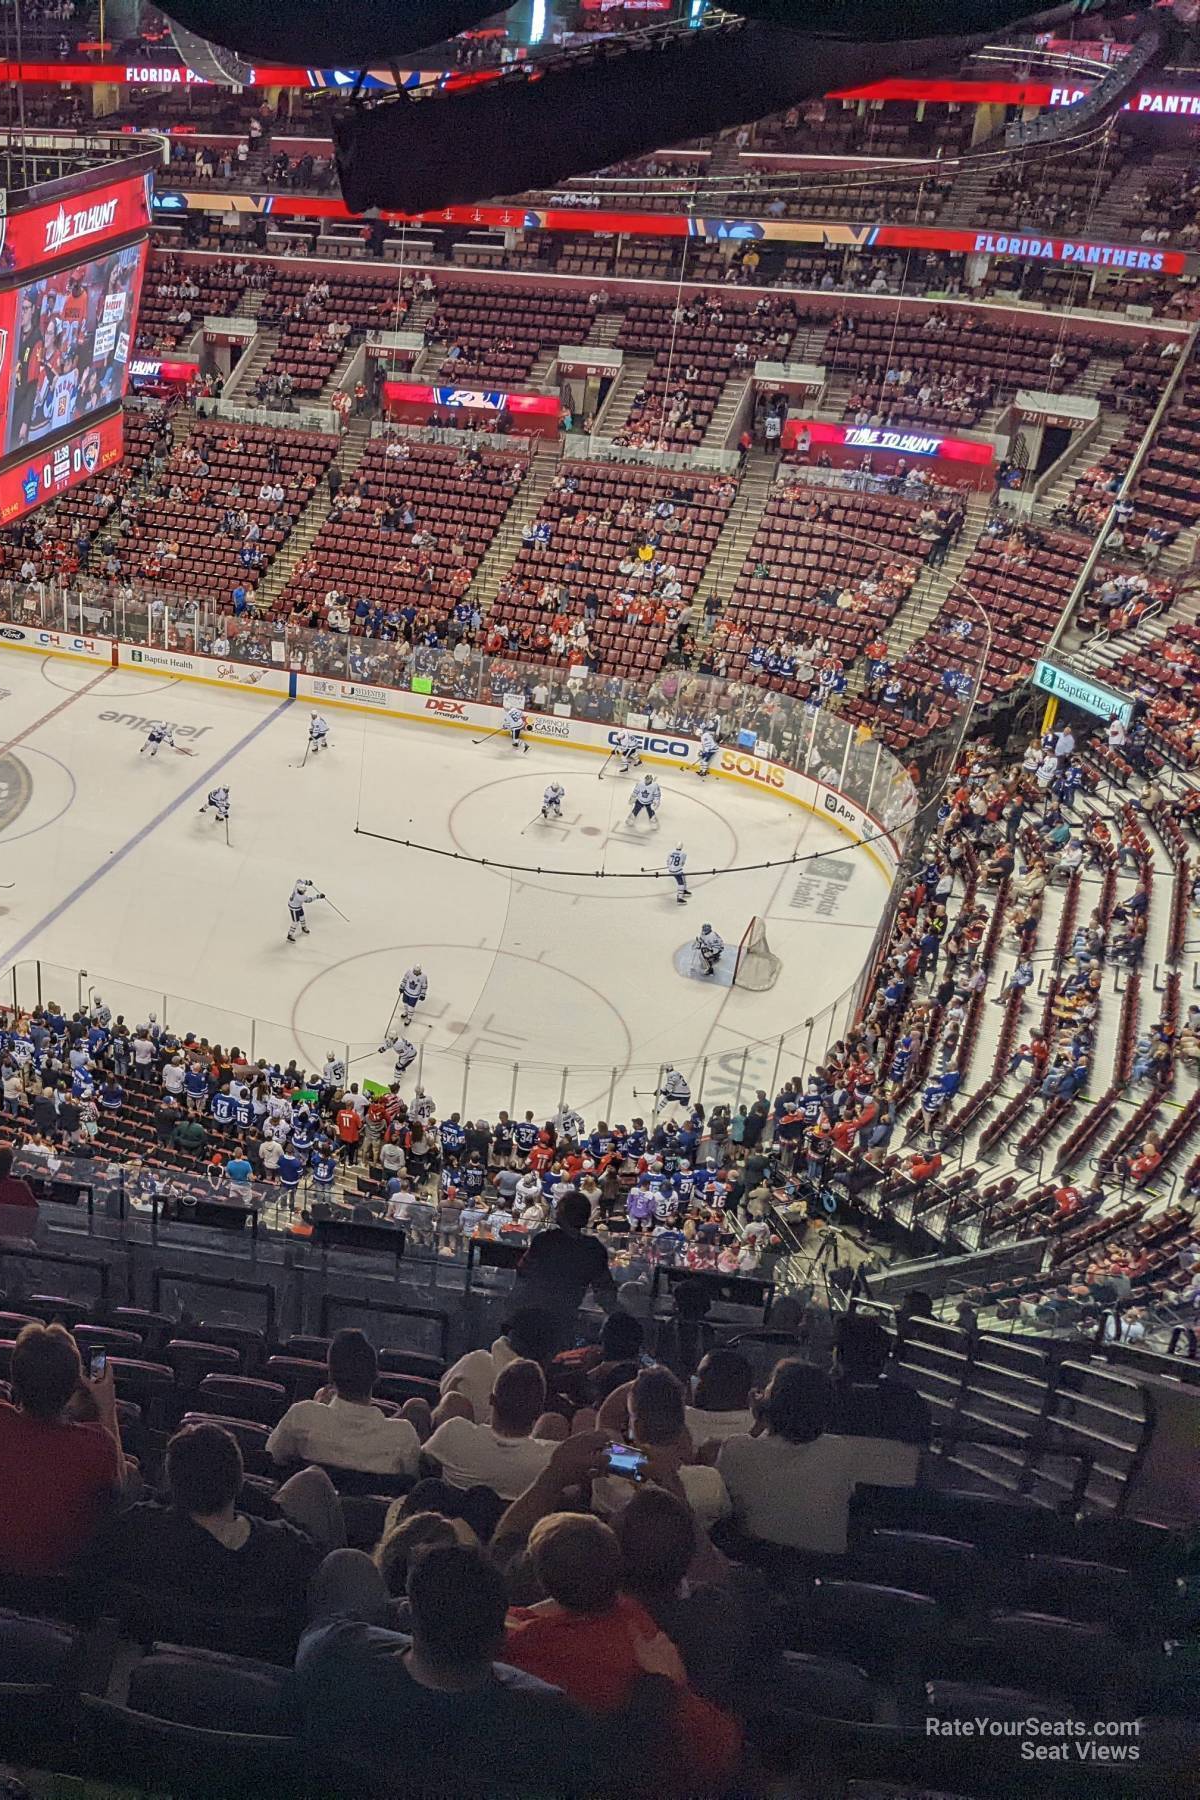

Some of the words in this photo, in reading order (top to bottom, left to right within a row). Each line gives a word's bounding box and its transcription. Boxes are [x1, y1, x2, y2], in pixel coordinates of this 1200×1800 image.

[126, 68, 181, 82] FLORIDA
[46, 203, 70, 253] TIME
[73, 212, 87, 233] TO
[87, 199, 118, 228] HUNT
[975, 235, 1054, 258] FLORIDA
[1061, 243, 1164, 270] PANTHERS
[132, 360, 162, 374] HUNT
[843, 428, 880, 444] TIME
[880, 432, 899, 447] TO
[899, 435, 942, 453] HUNT
[43, 464, 52, 488] 0
[54, 446, 69, 462] 11:39
[74, 448, 81, 472] 0
[1, 628, 21, 640] Ford
[39, 634, 60, 645] CH
[74, 639, 94, 650] CH
[144, 654, 168, 666] Baptist
[170, 658, 193, 670] Health
[1057, 676, 1091, 706] Baptist
[1092, 694, 1124, 719] Health
[425, 698, 468, 714] DEX
[433, 711, 469, 722] imaging
[534, 723, 570, 736] CASINO
[720, 750, 785, 788] SOLIS
[789, 877, 814, 910] Health
[816, 880, 849, 916] Baptist
[216, 1104, 228, 1117] 14
[417, 1107, 430, 1118] 43
[236, 1112, 248, 1124] 16
[342, 1116, 350, 1127] 11
[520, 1133, 533, 1144] 34
[712, 1195, 726, 1208] 16
[658, 1204, 674, 1216] 34
